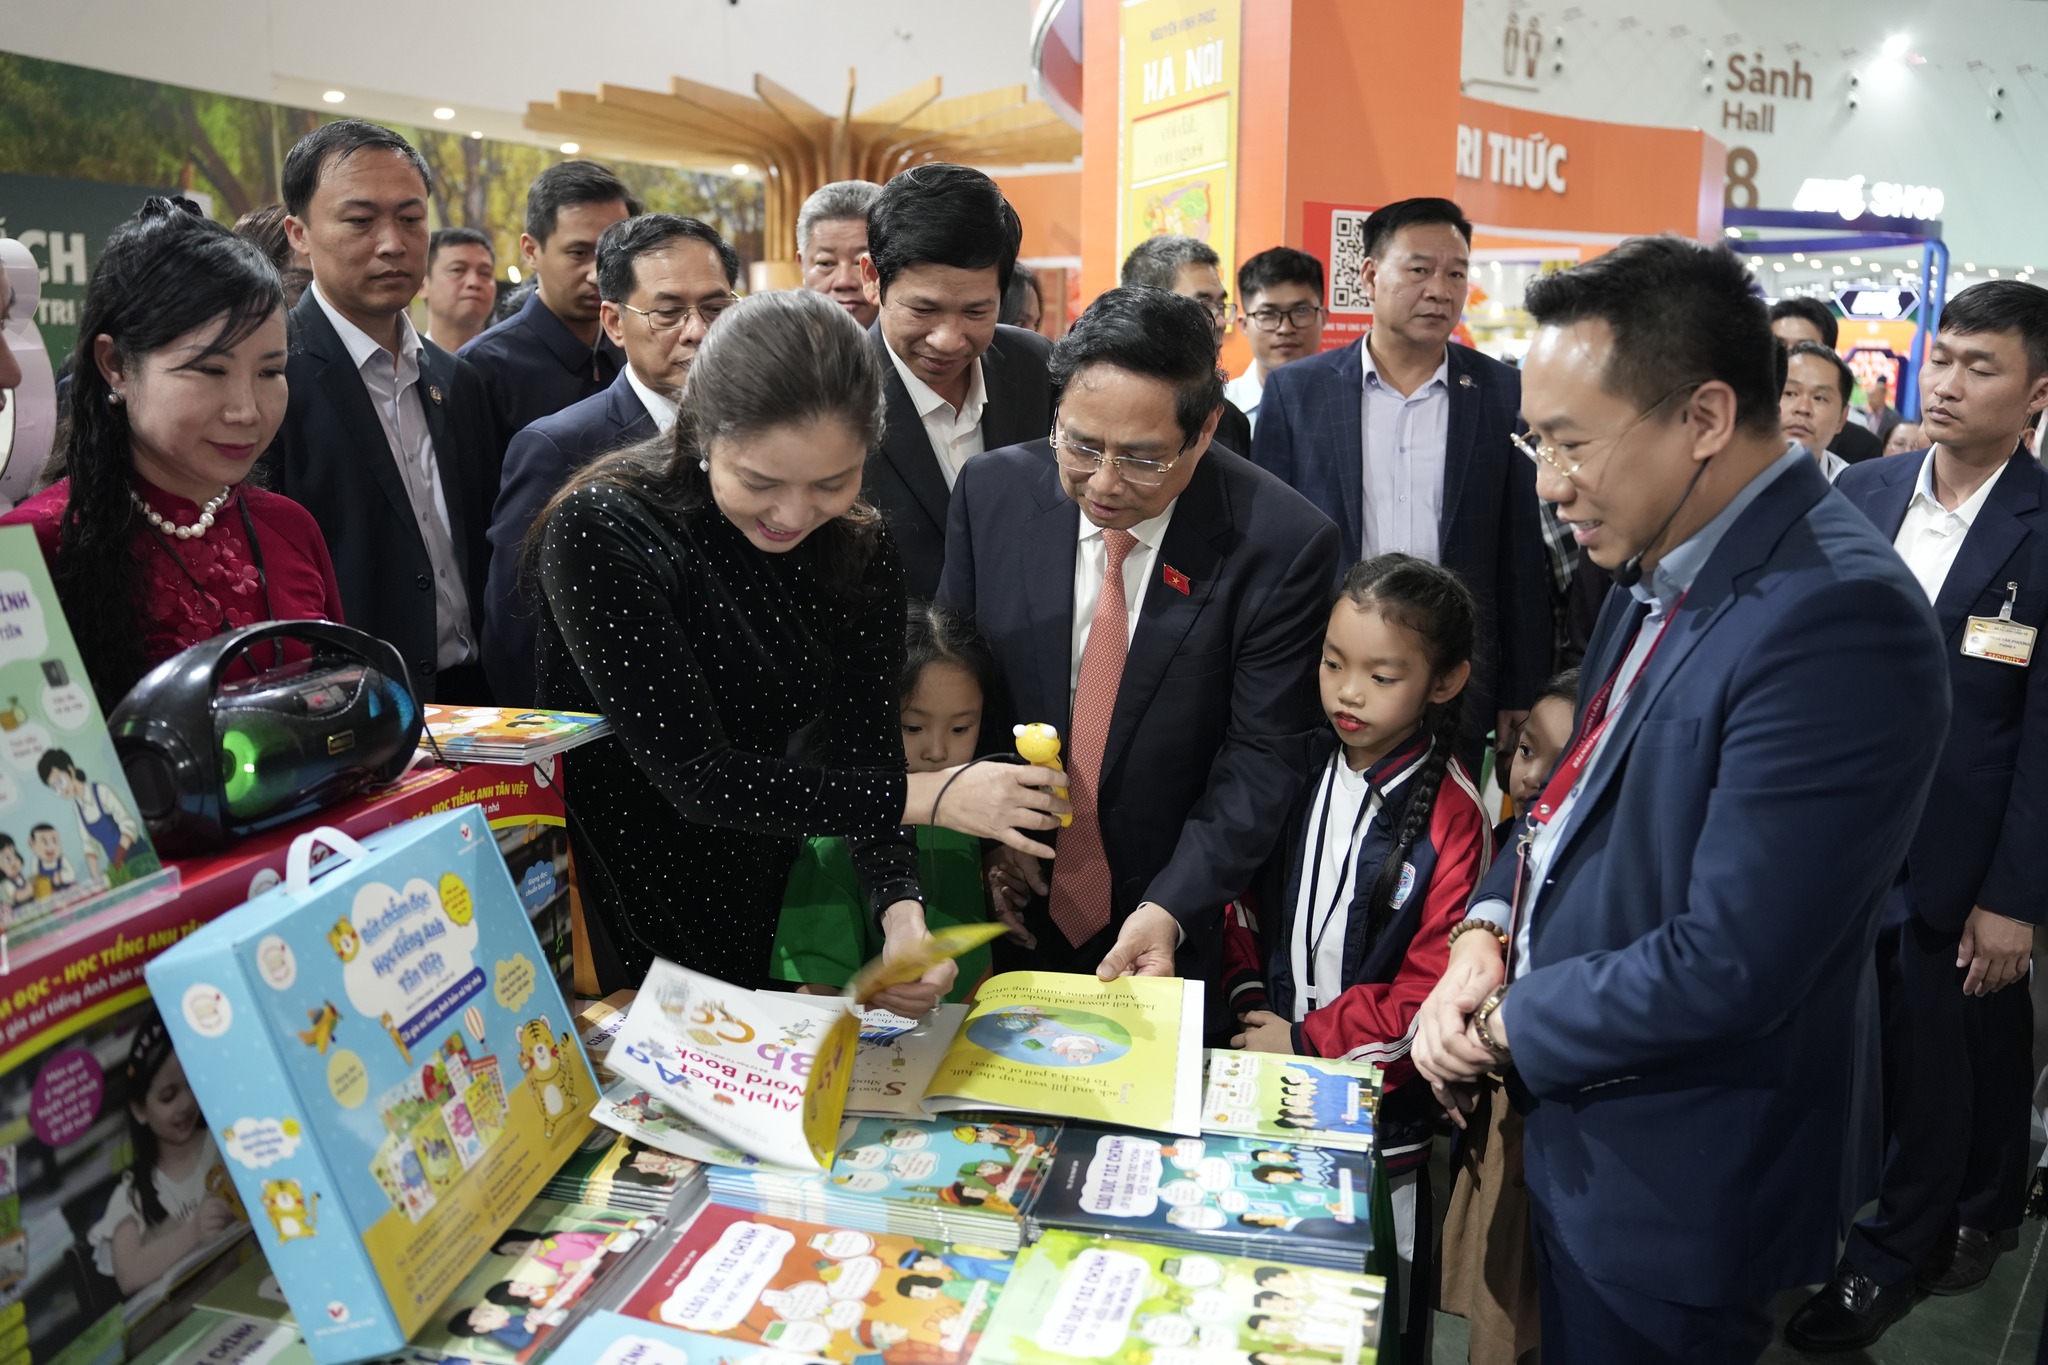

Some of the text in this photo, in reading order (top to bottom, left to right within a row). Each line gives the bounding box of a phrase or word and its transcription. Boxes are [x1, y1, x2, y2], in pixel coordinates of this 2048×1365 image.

[1184, 36, 1224, 92] NỘI
[1726, 52, 1813, 100] Sảnh
[1721, 99, 1775, 134] Hall
[1456, 123, 1568, 194] RI THỨC
[1725, 147, 1758, 210] 8
[451, 786, 476, 808] TIẾNG
[476, 786, 494, 801] ANH
[495, 780, 511, 797] TÂN
[511, 780, 529, 799] VIỆT
[409, 891, 431, 915] đọc
[371, 952, 397, 978] Học
[422, 916, 446, 943] Anh
[64, 954, 99, 984] HỌC
[100, 932, 145, 967] TIẾNG
[147, 927, 178, 950] ANH
[83, 977, 109, 998] Anh
[1011, 985, 1062, 996] tumbling
[1003, 993, 1018, 1002] his
[1020, 994, 1052, 1004] broke
[1065, 990, 1095, 998] came
[1116, 993, 1139, 1001] And
[1053, 997, 1076, 1006] and
[1079, 1000, 1110, 1008] down
[1112, 1001, 1131, 1009] fell
[1133, 1003, 1156, 1011] Jack
[675, 1046, 737, 1078] Book
[976, 1070, 996, 1080] the
[1008, 1066, 1022, 1074] of
[1026, 1069, 1049, 1078] pail
[1000, 1075, 1015, 1083] up
[1061, 1073, 1090, 1083] fetch
[1094, 1077, 1111, 1086] To
[679, 1063, 799, 1112] Alphabet
[1019, 1079, 1049, 1088] went
[1073, 1085, 1096, 1094] and
